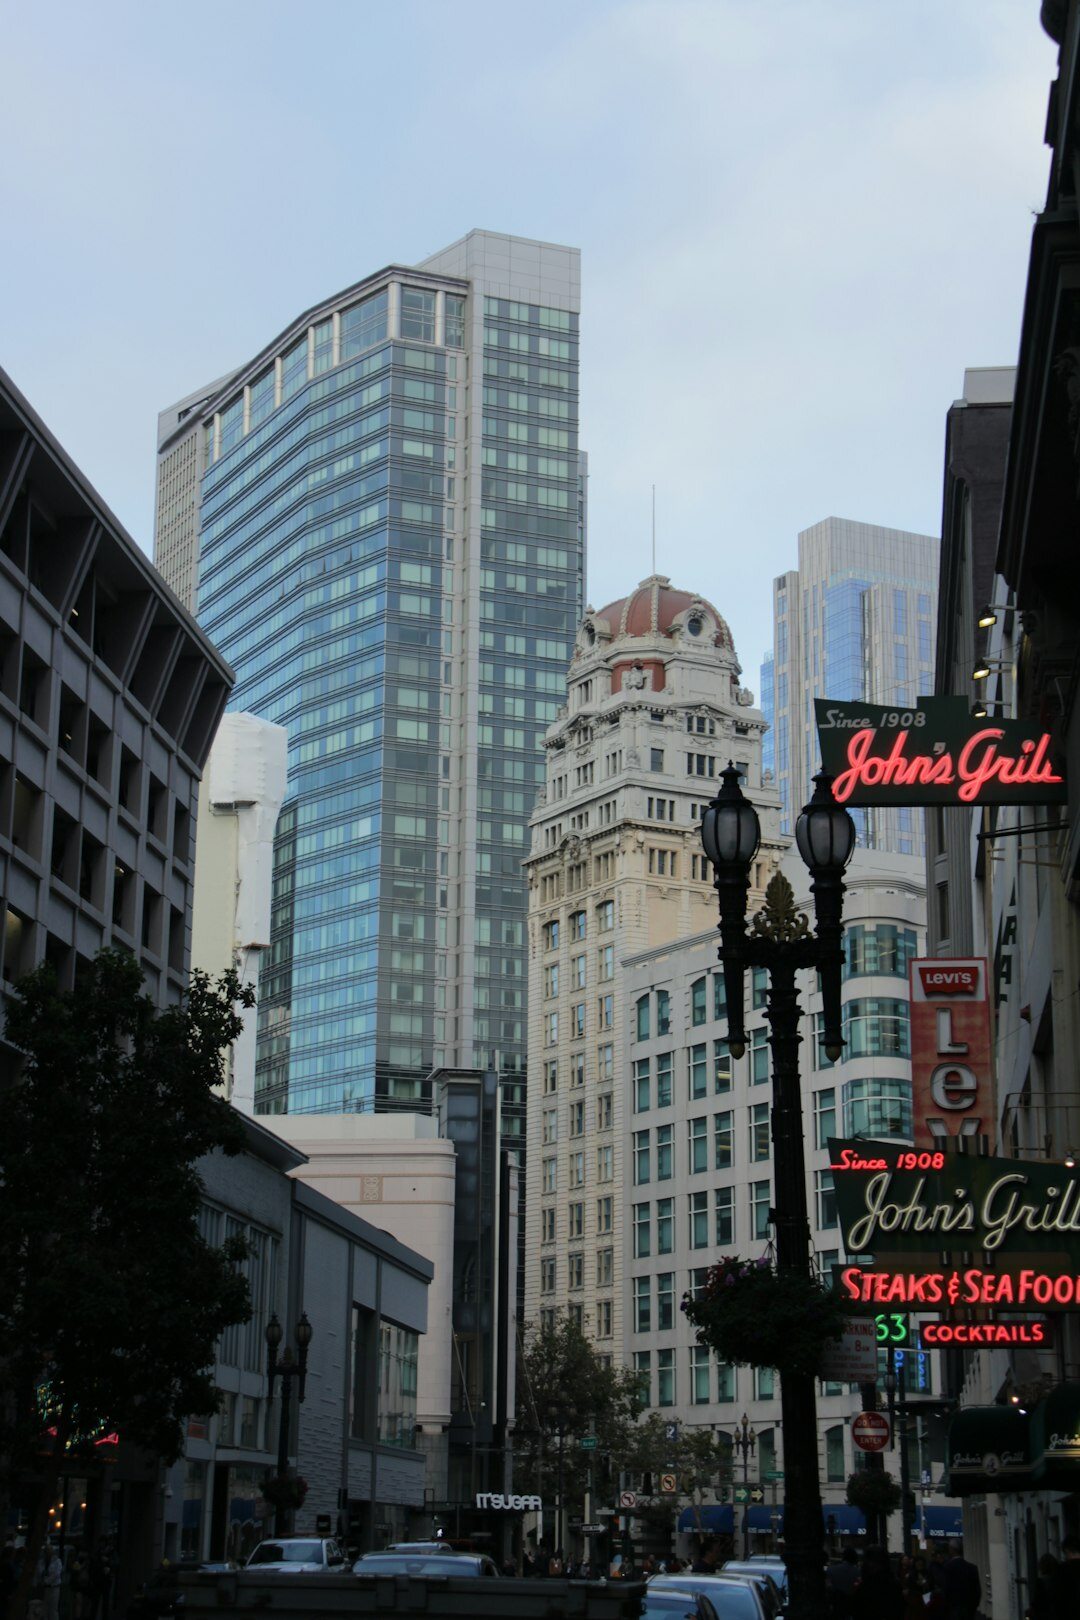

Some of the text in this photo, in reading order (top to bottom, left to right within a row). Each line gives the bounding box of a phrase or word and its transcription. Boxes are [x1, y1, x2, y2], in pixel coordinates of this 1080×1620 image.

[818, 709, 927, 729] Since 1908
[831, 728, 956, 803] John's
[829, 1148, 945, 1171] Since 1908
[847, 1172, 976, 1252] John's
[840, 1268, 944, 1304] STEAKS
[947, 1271, 961, 1306] &
[962, 1269, 1014, 1304] SEA
[874, 1313, 909, 1342] 63
[922, 1323, 1045, 1343] COCKTAILS
[859, 1437, 882, 1445] ENTER
